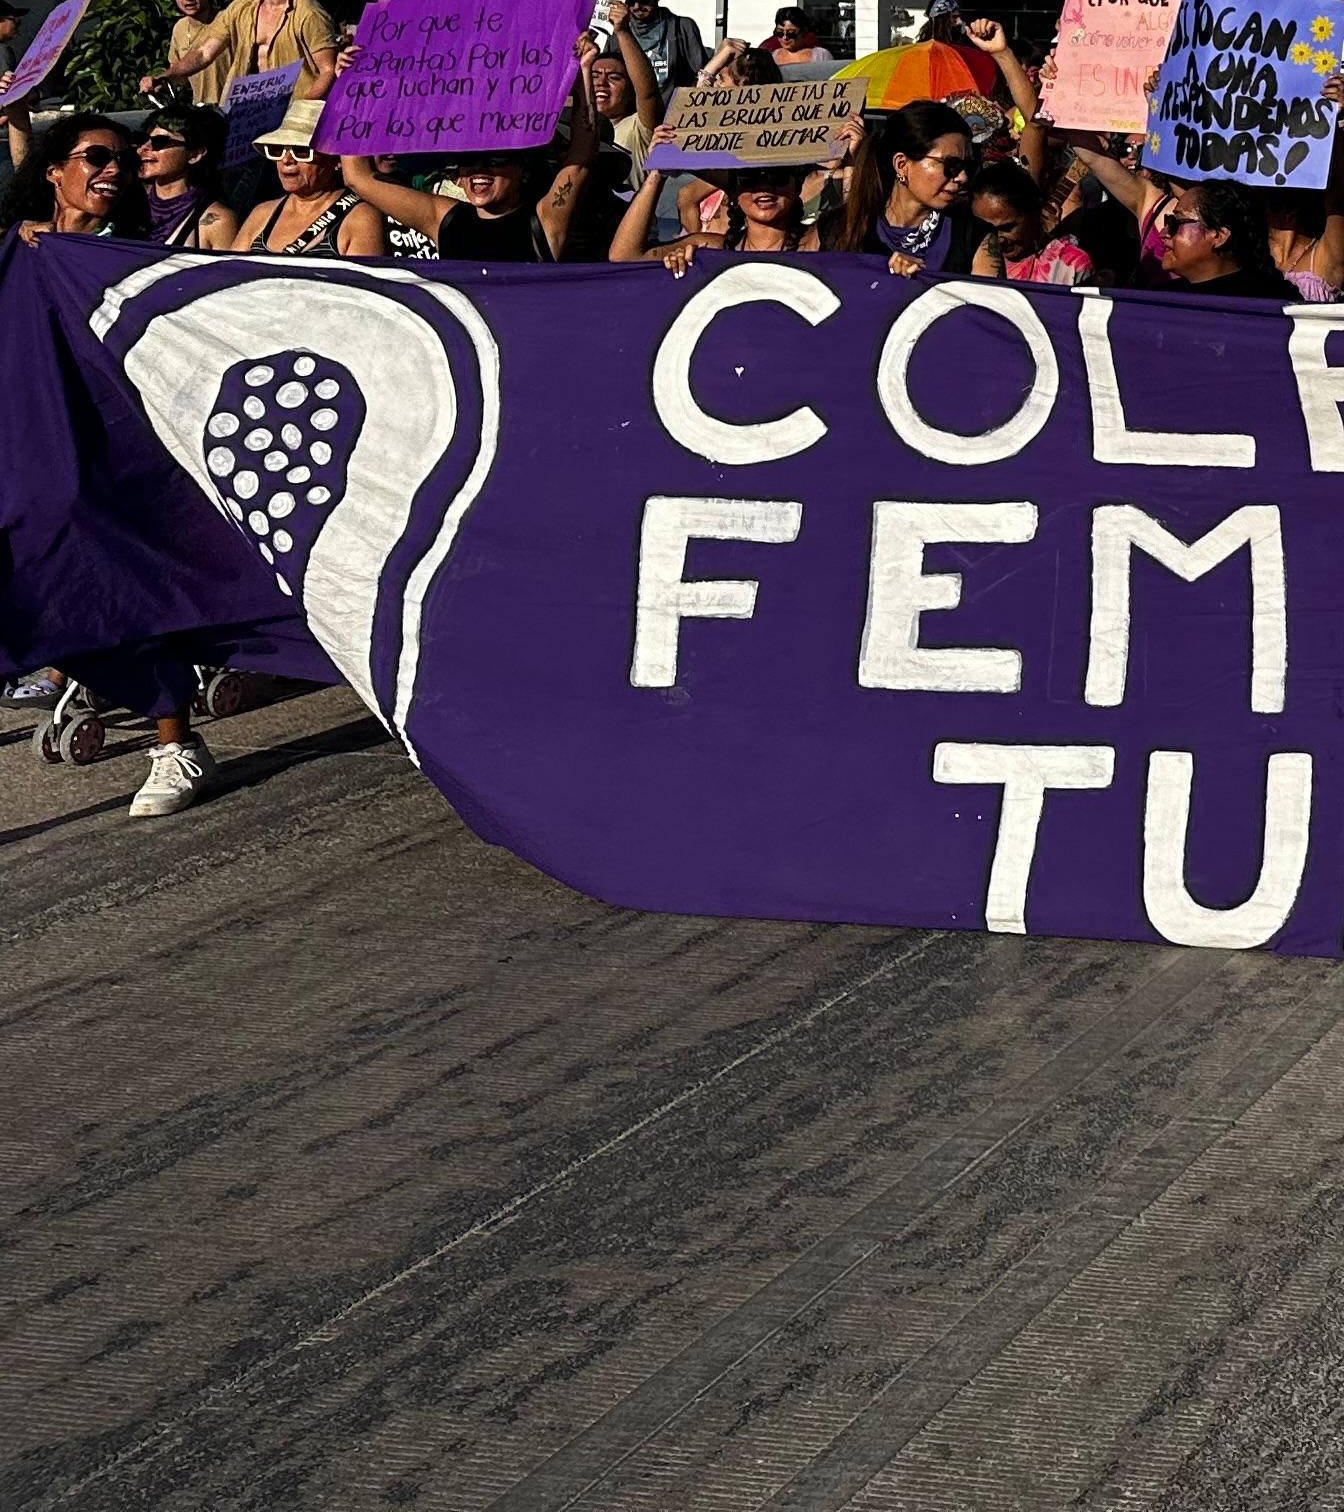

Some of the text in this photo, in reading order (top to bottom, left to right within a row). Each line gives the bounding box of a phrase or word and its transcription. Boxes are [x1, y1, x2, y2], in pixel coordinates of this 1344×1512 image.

[368, 6, 505, 45] Por que te
[466, 42, 511, 73] Por
[520, 39, 554, 67] las
[344, 77, 389, 110] que
[396, 71, 475, 100] luchan
[509, 73, 544, 94] no
[1187, 51, 1279, 98] A UNA
[684, 81, 852, 109] SOMOS LAS NIETAS DE
[1159, 79, 1334, 140] RESPONDEMOS
[336, 109, 560, 145] Por las que mueren
[676, 99, 852, 130] LAS BRUJAS QUE NO
[755, 124, 830, 148] QUEMAR
[307, 210, 337, 236] PINK
